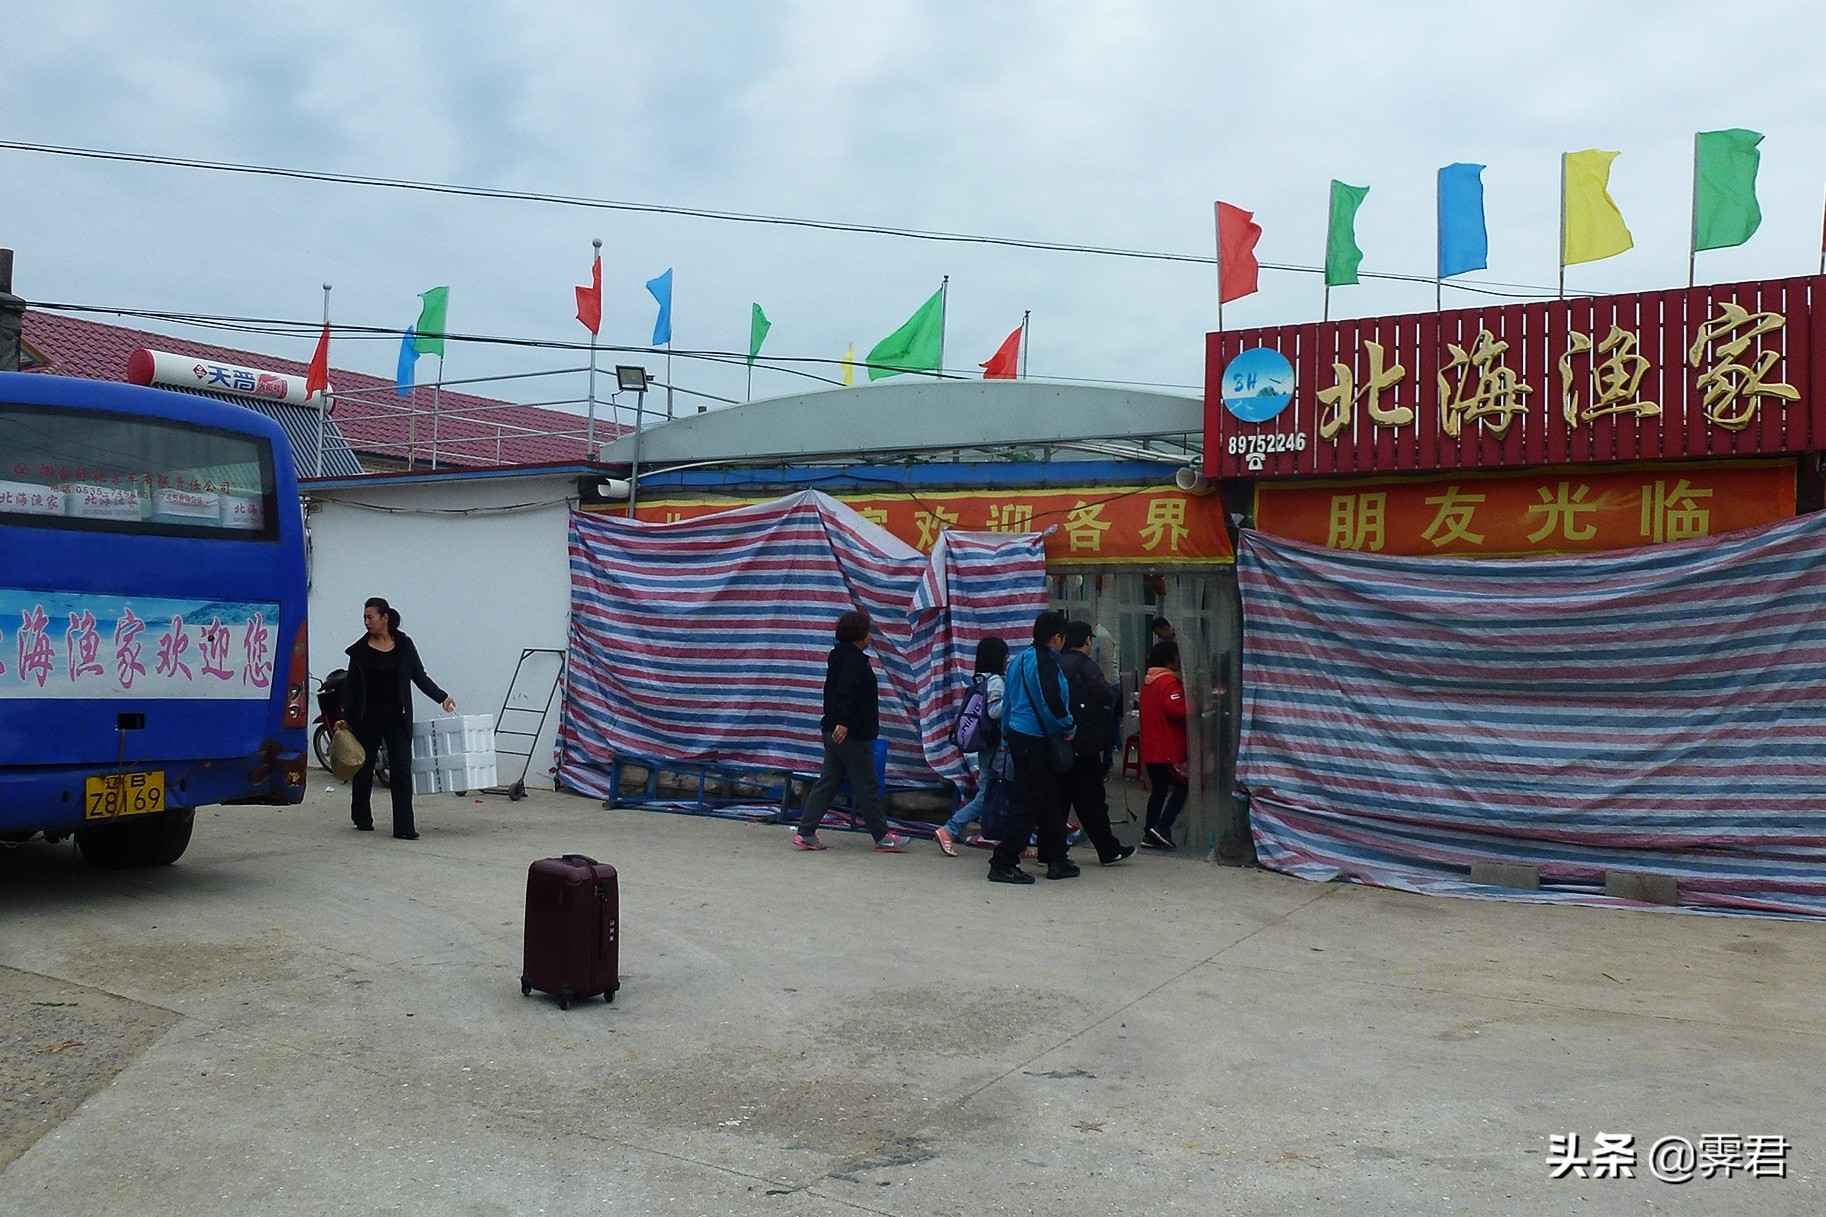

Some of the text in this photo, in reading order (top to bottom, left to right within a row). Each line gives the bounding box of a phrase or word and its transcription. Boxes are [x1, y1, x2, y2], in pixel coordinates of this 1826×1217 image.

[1316, 301, 1802, 442] 北海渔家
[1228, 432, 1307, 455] 89752246
[1326, 479, 1713, 551] 朋友光临
[0, 604, 273, 690] 海渔家欢迎您
